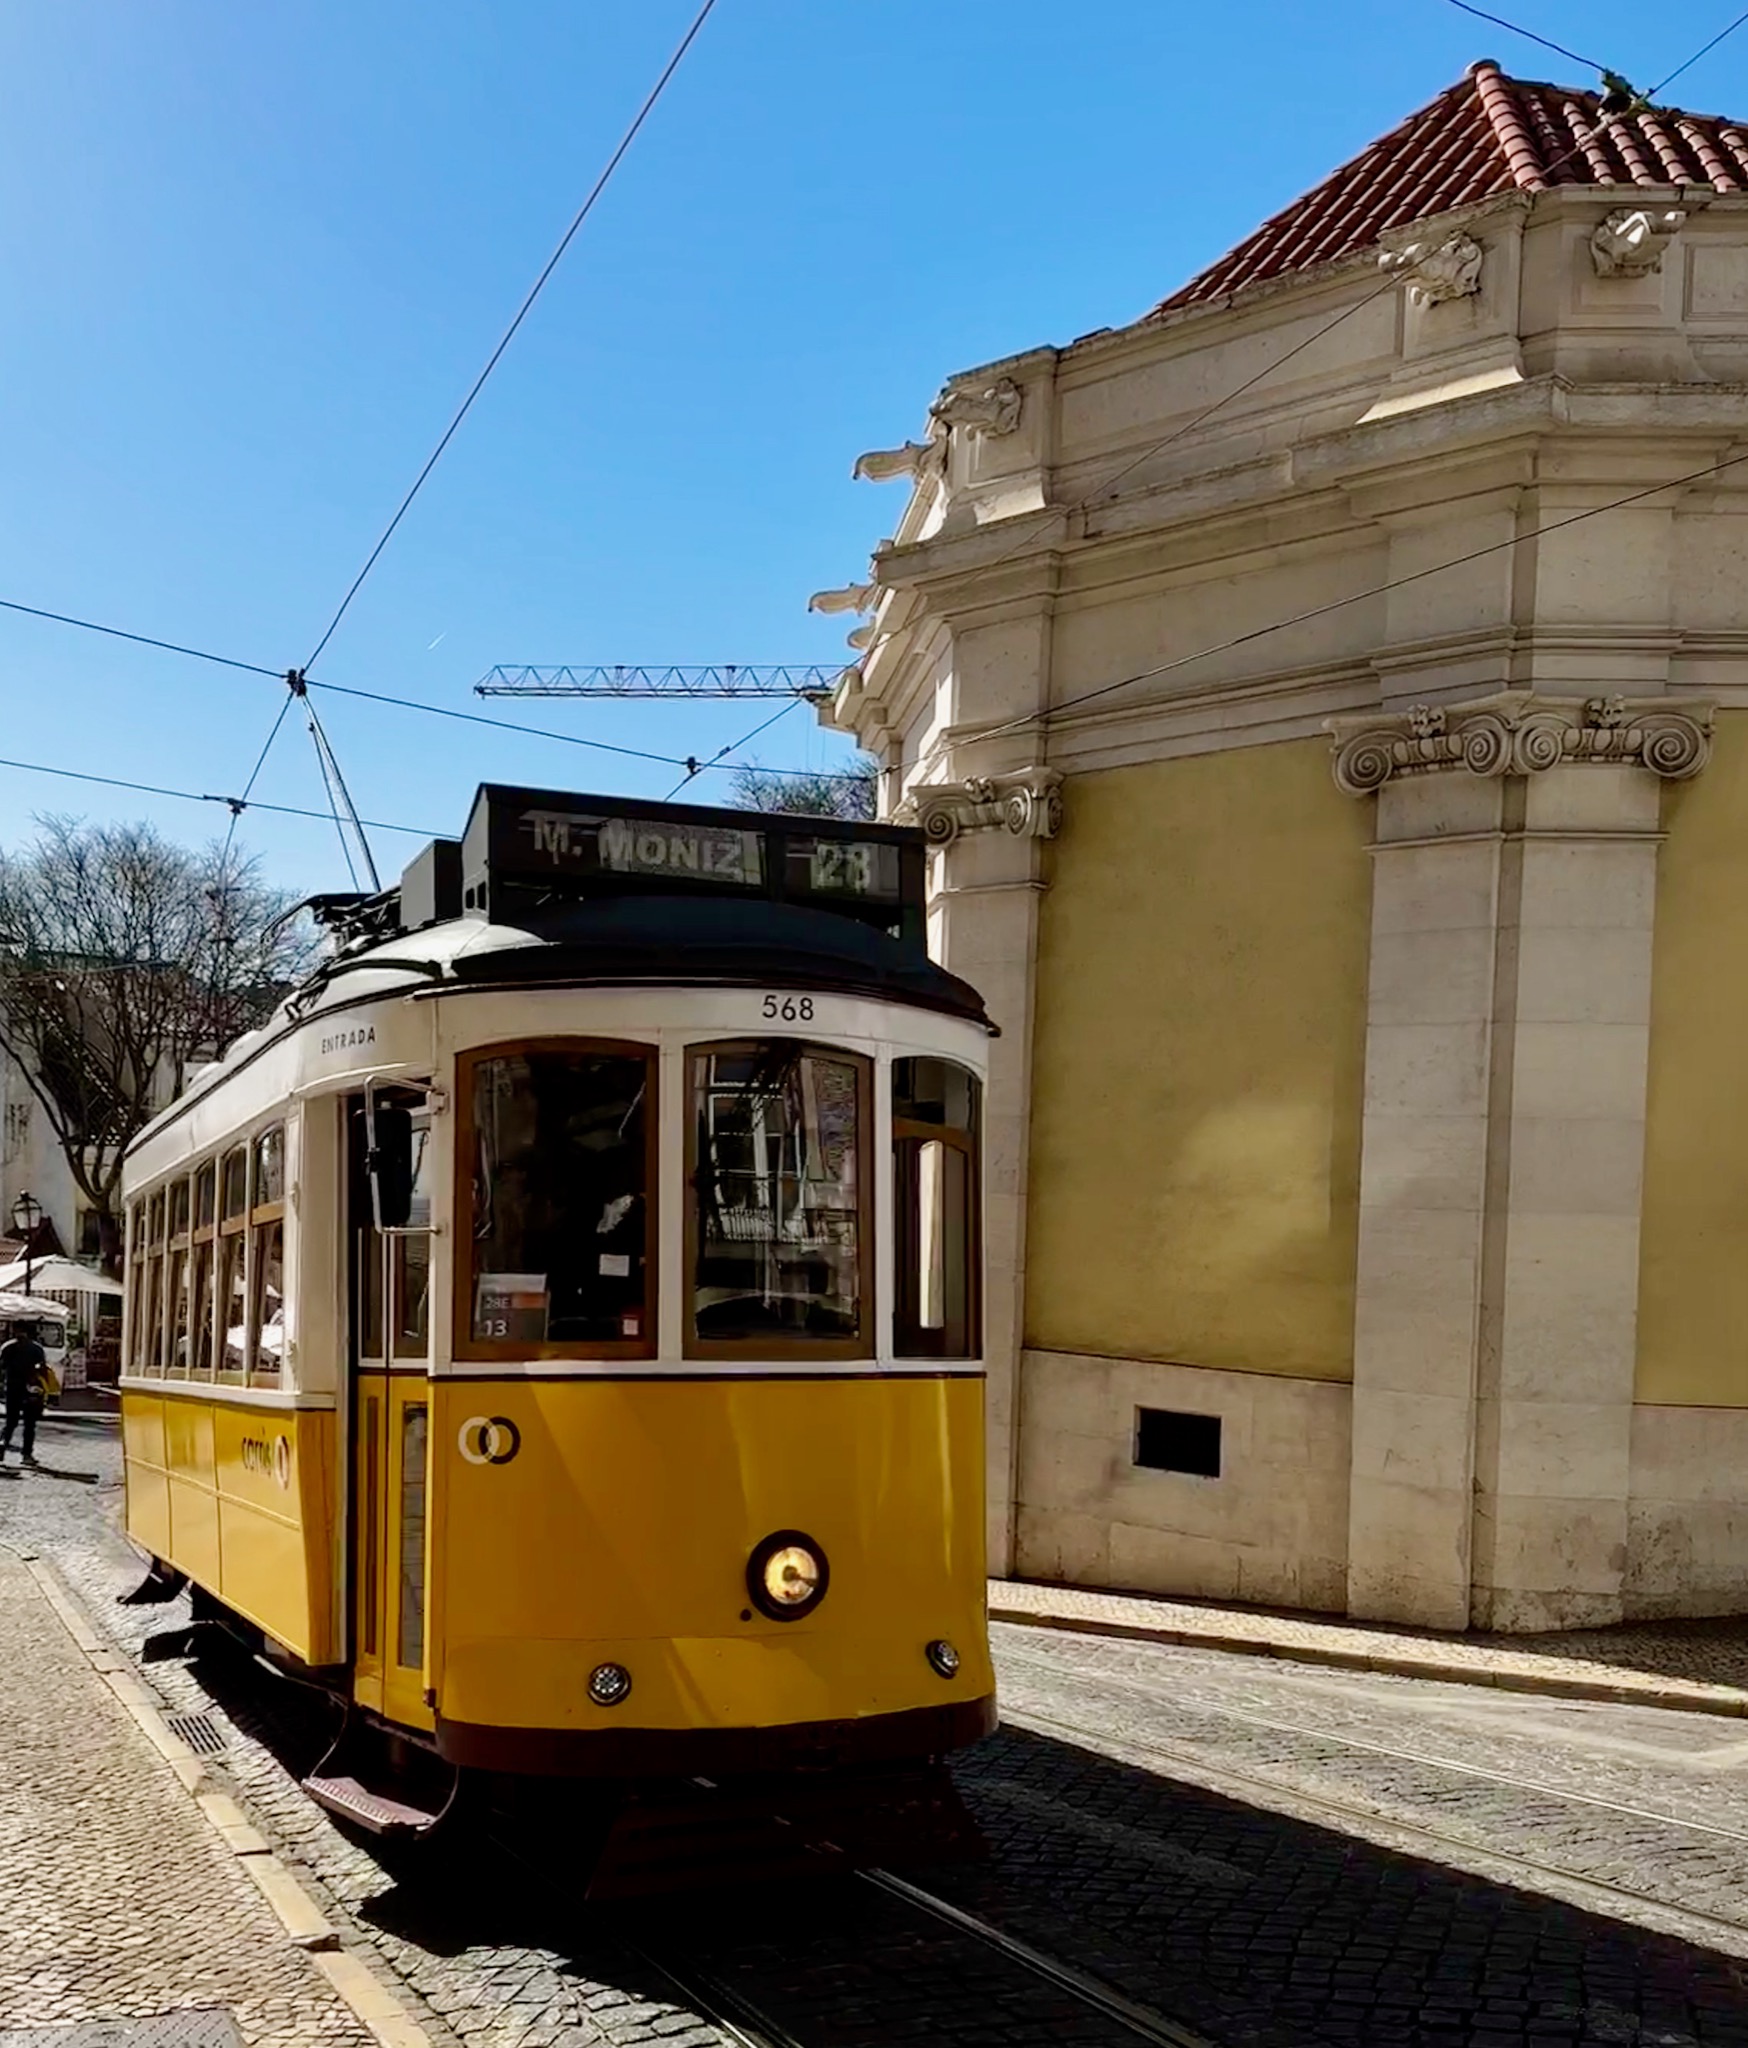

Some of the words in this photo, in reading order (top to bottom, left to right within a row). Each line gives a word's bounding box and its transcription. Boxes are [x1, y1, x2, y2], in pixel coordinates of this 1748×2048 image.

[533, 816, 583, 863] M.
[599, 820, 743, 875] MONIZ
[817, 843, 870, 893] 28
[762, 994, 814, 1021] 568
[321, 1026, 376, 1054] ENTRADA
[484, 1319, 507, 1336] 13
